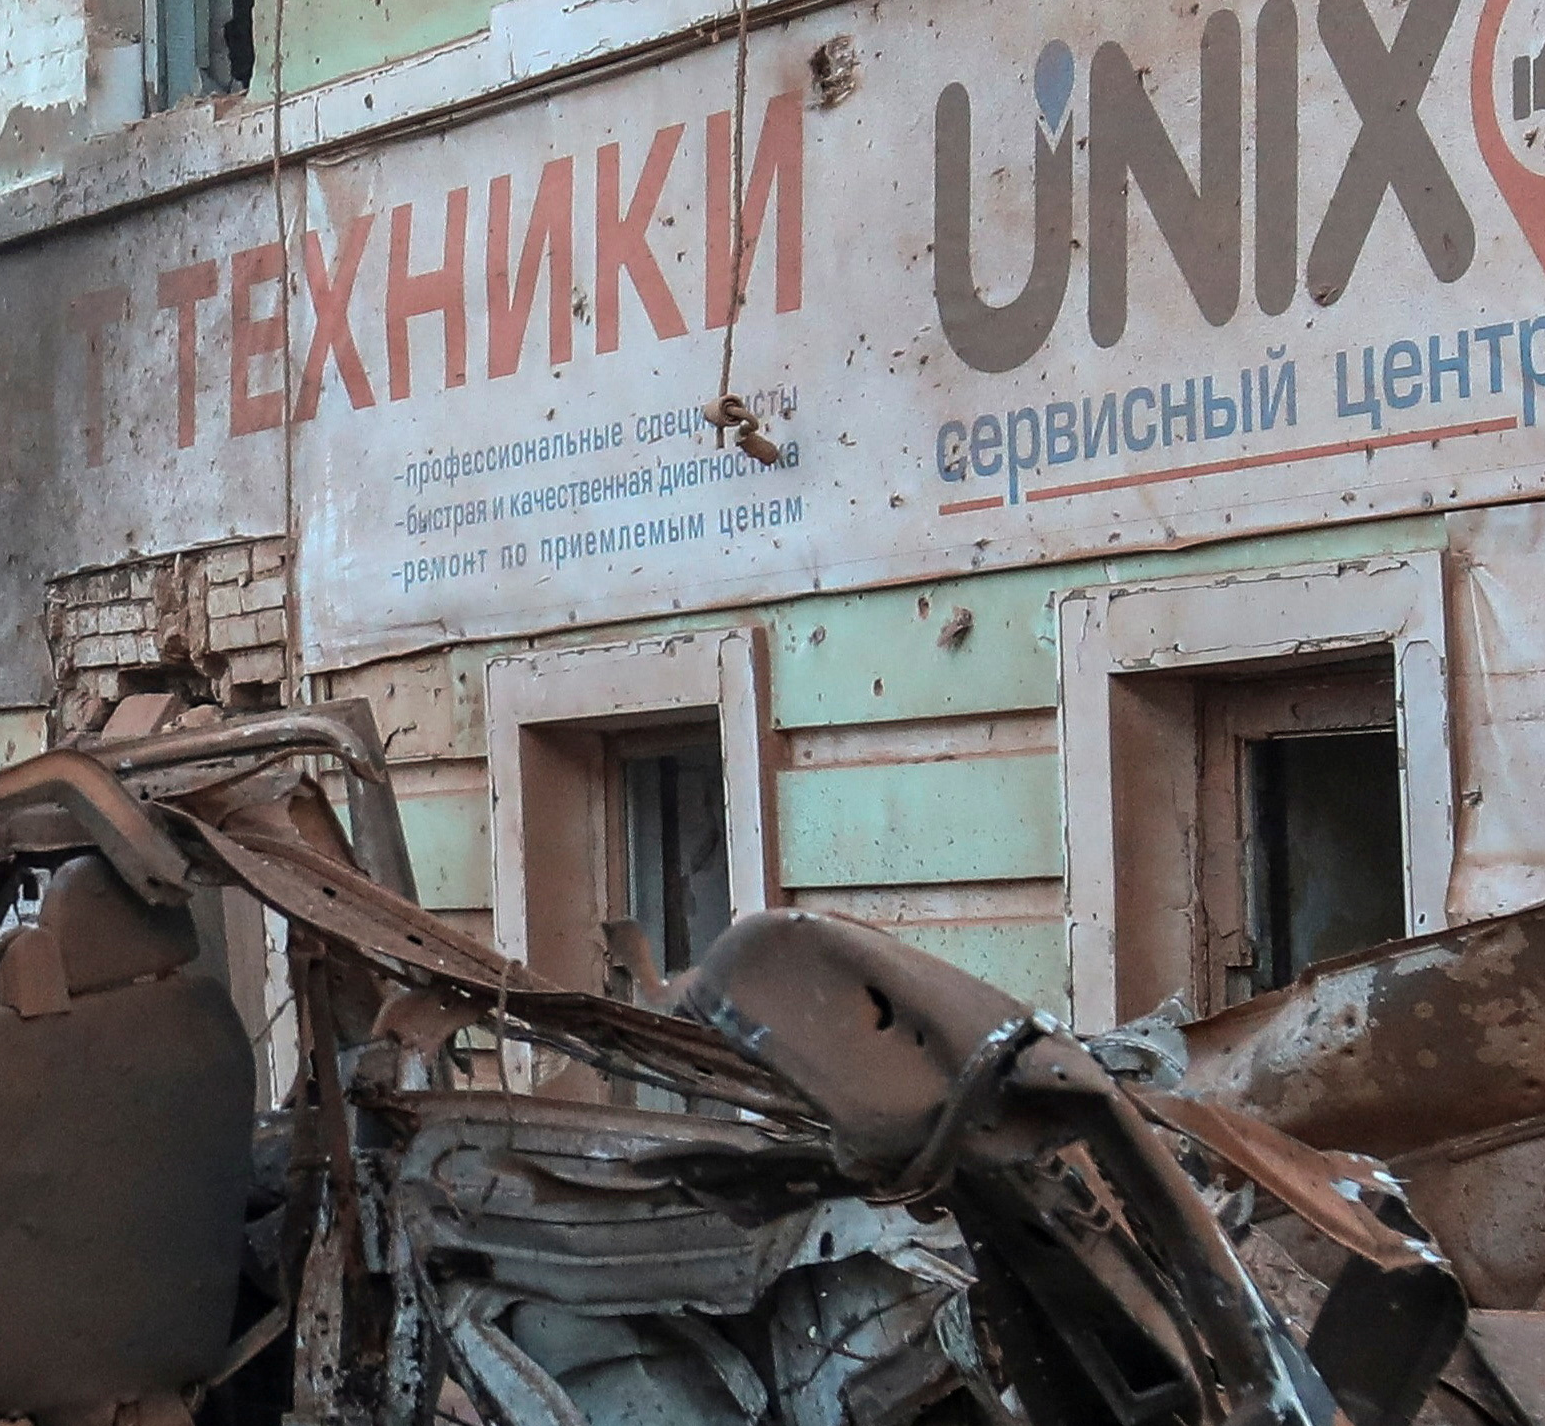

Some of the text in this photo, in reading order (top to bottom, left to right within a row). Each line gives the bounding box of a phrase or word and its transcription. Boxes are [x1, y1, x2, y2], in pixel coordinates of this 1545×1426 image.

[157, 88, 804, 450] ТЕХНИКИ
[935, 345, 1298, 505] сервисный
[493, 494, 505, 522] и
[510, 469, 653, 517] качественная
[501, 541, 527, 570] по
[540, 511, 705, 570] приемлемым
[720, 494, 804, 540] ценам
